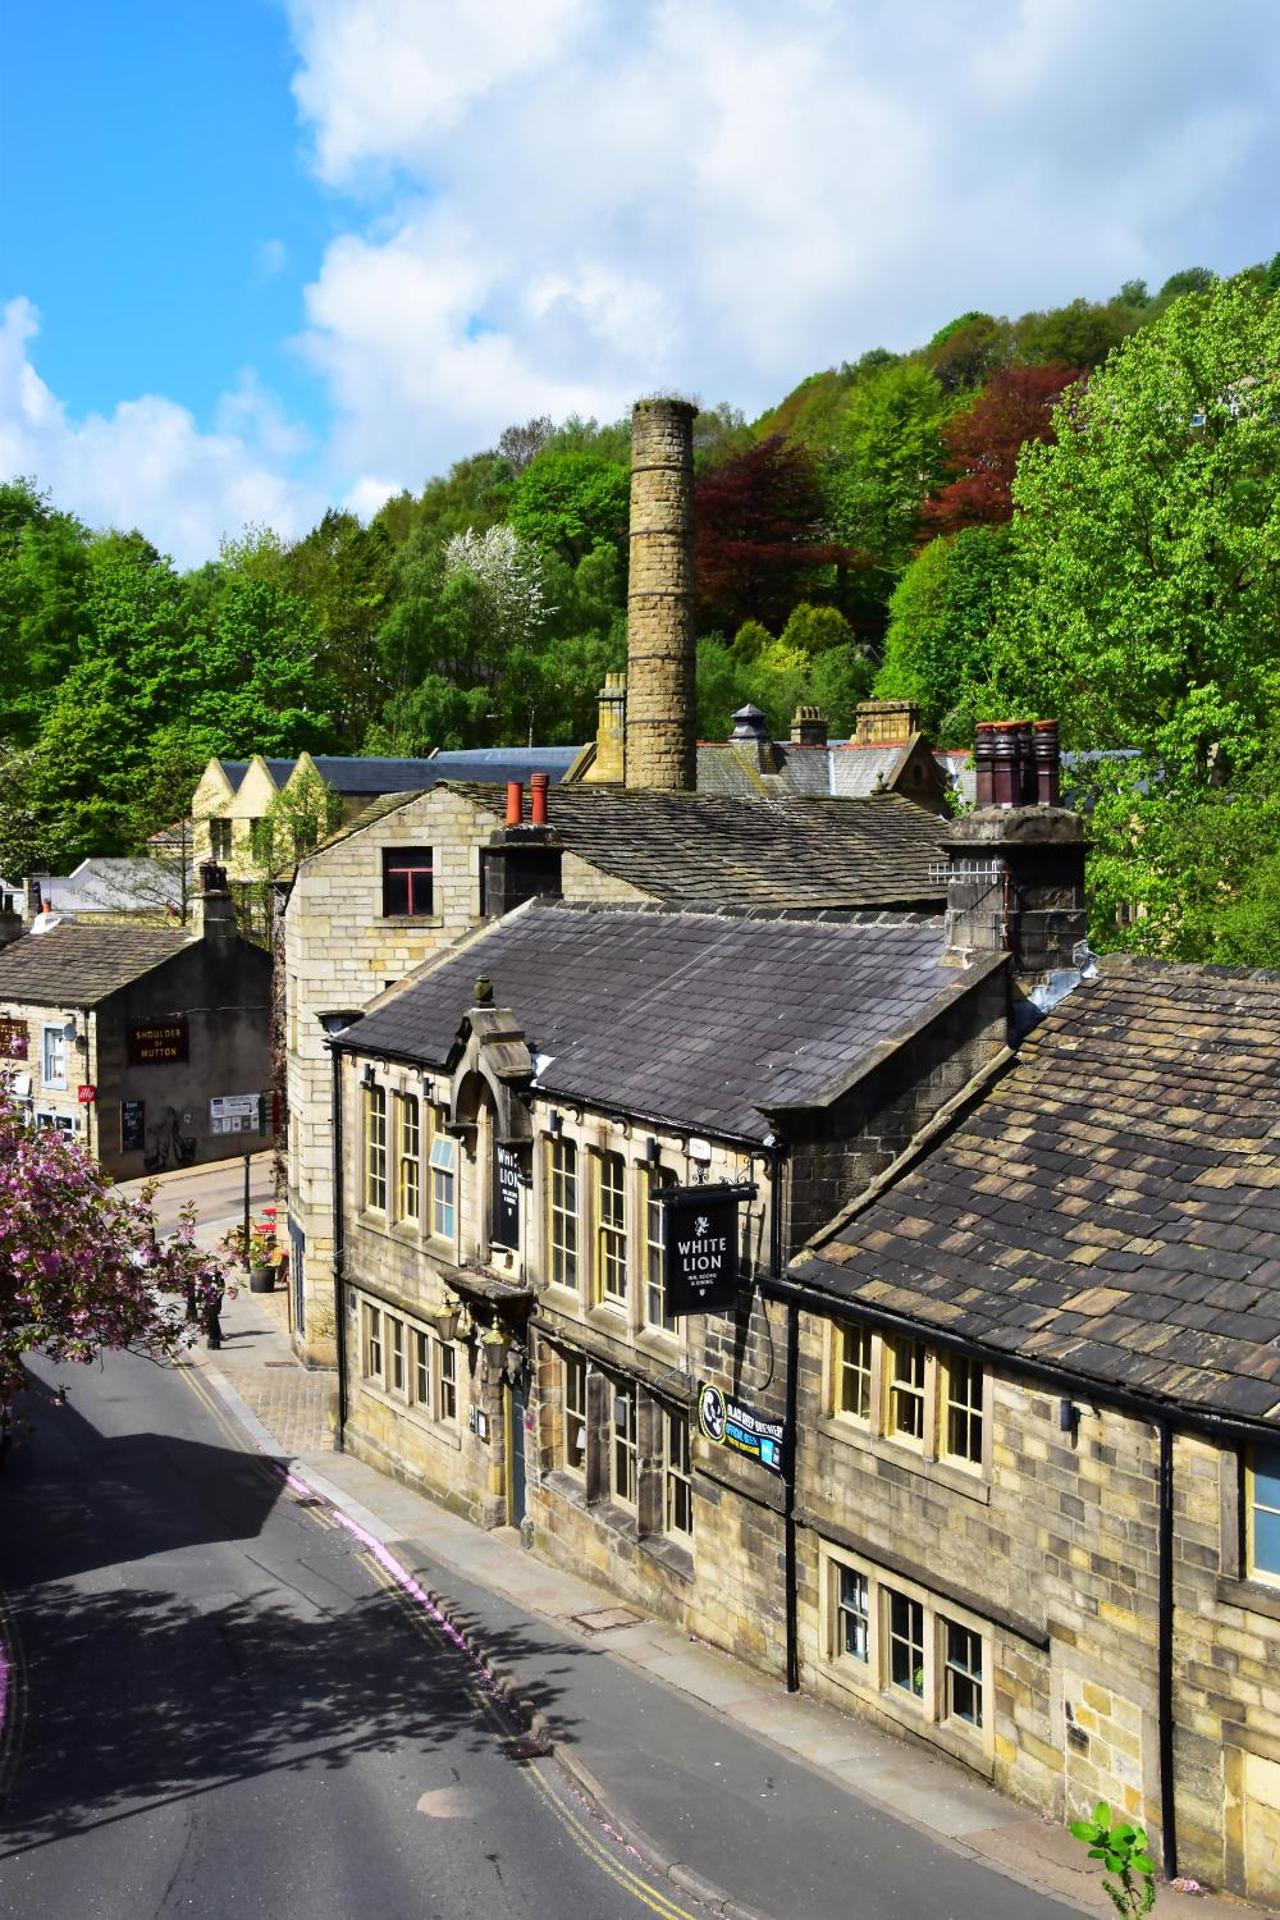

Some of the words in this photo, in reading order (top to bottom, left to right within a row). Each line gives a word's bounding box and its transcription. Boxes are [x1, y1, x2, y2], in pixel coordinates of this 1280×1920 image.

[135, 1028, 181, 1040] SHOULDER
[140, 1047, 177, 1057] MUTTON
[80, 1087, 95, 1099] illy
[497, 1147, 518, 1168] WHI
[678, 1237, 727, 1255] WHITE
[683, 1255, 722, 1272] LION
